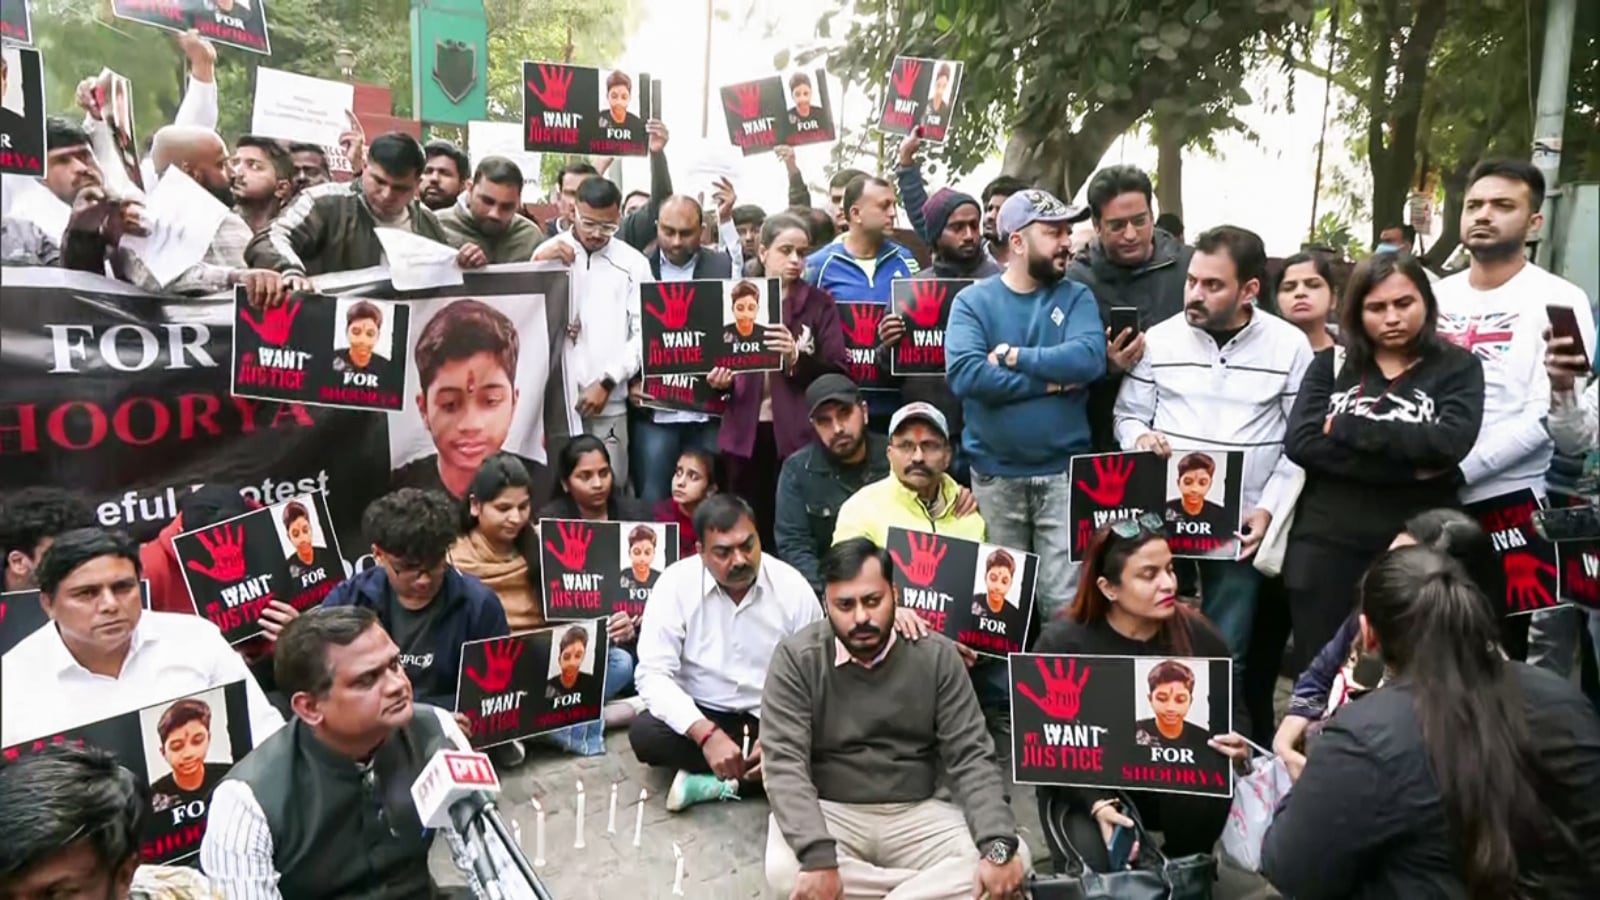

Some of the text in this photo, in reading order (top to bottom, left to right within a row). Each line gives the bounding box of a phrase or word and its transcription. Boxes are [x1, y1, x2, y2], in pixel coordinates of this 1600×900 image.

[543, 111, 583, 128] WANT
[742, 117, 776, 136] WANT
[797, 119, 819, 131] FOR
[607, 128, 631, 139] FOR
[662, 331, 707, 348] WANT
[733, 342, 760, 353] FOR
[913, 330, 945, 346] WAN
[44, 322, 219, 374] FOR
[258, 347, 312, 370] WANT
[343, 372, 379, 387] FOR
[662, 375, 699, 389] WANT
[0, 393, 315, 453] HOORYA
[97, 487, 178, 527] eful
[1176, 521, 1212, 534] FOR
[301, 567, 327, 588] FOR
[562, 573, 604, 591] WANT
[220, 573, 272, 608] WANT
[904, 587, 954, 611] WANT
[979, 617, 1007, 635] FOR
[481, 690, 528, 717] WANT
[553, 692, 581, 709] FOR
[1043, 723, 1108, 748] WANT
[1021, 745, 1104, 771] JUSTICE
[1151, 747, 1195, 764] FOR
[450, 758, 492, 782] PTI
[1121, 764, 1226, 788] SHOORYA
[172, 800, 206, 826] FO
